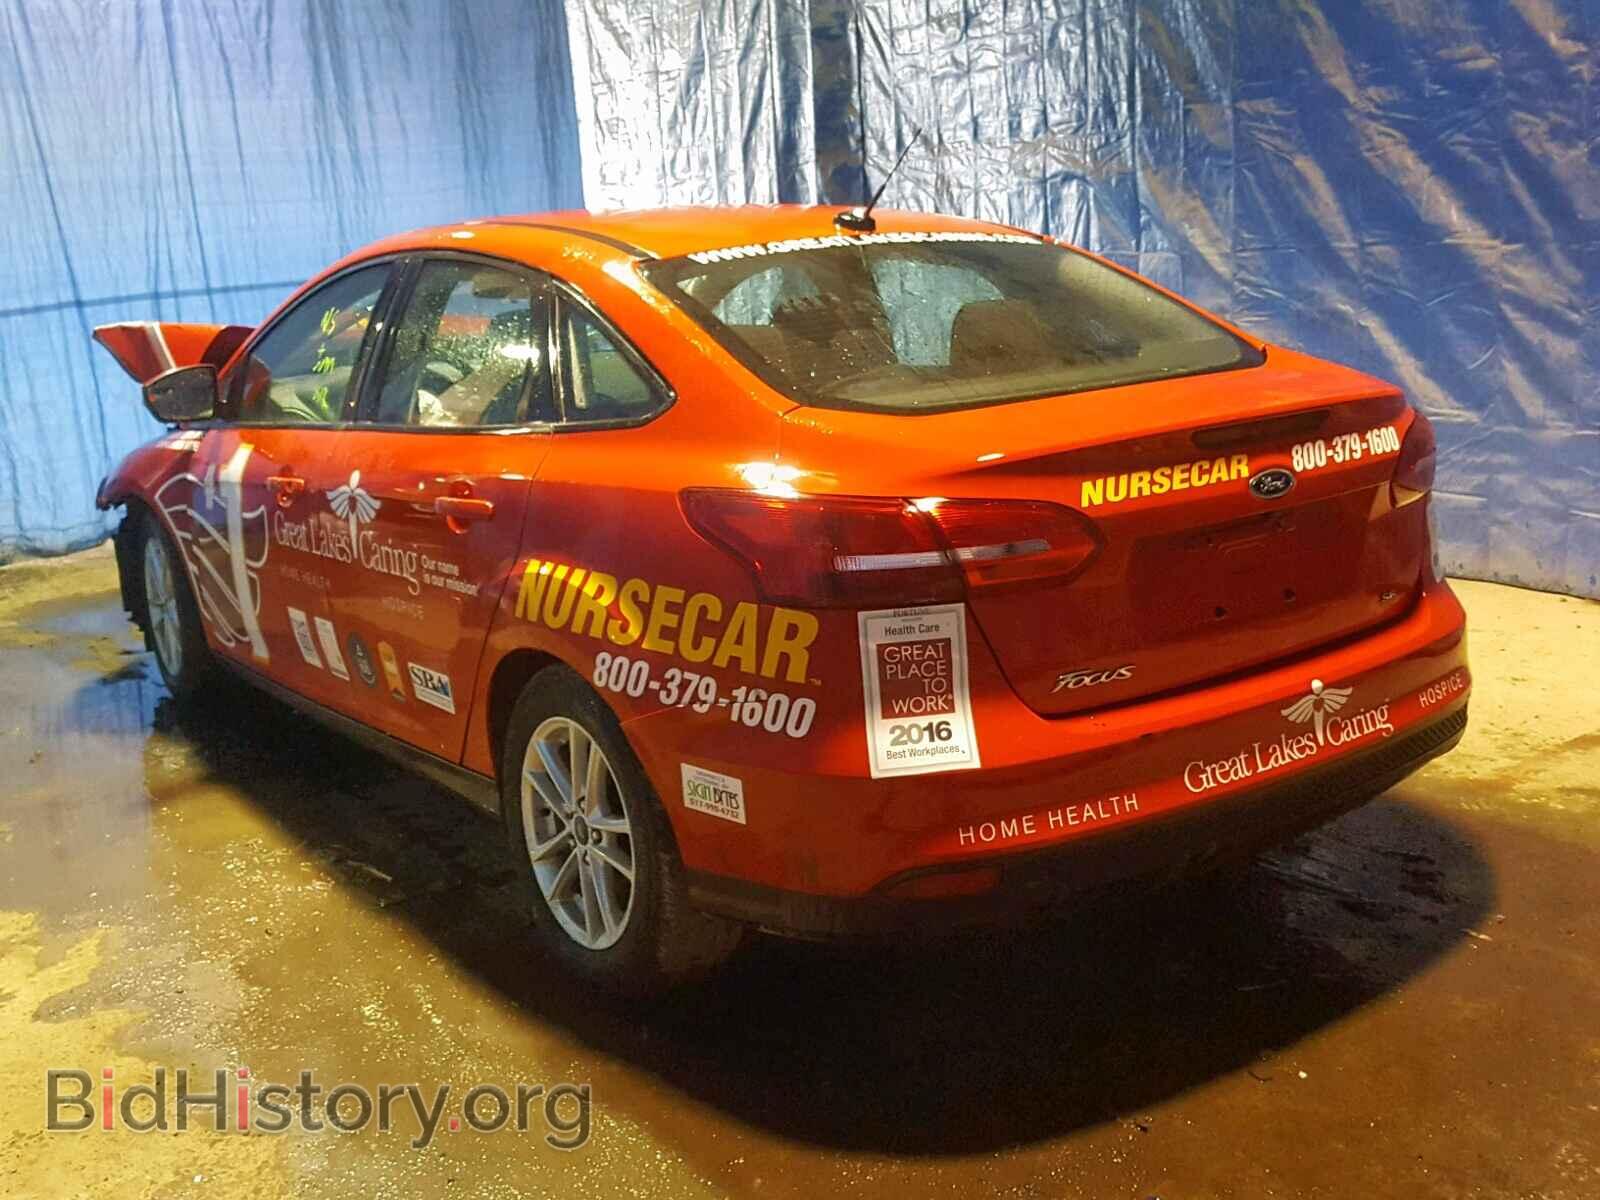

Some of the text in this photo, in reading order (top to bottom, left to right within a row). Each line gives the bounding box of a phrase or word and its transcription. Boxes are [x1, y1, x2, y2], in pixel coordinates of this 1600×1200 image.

[1291, 426, 1401, 473] 800-379-1600
[1080, 454, 1250, 508] NURSECAR
[274, 510, 420, 596] Great Lakes Caring
[514, 558, 820, 684] NURSECAR
[884, 623, 940, 637] Health Care
[883, 642, 945, 663] GREAT
[886, 659, 947, 681] PLACE
[592, 651, 817, 739] 800-379-1600
[922, 677, 947, 695] TO
[1418, 672, 1464, 708] HOSPICE
[891, 695, 949, 715] WORK
[889, 720, 953, 747] 2016
[1183, 704, 1395, 793] Great Lakes Caring
[886, 744, 960, 761] Best Workplaces
[958, 793, 1140, 846] HOME HEALTH
